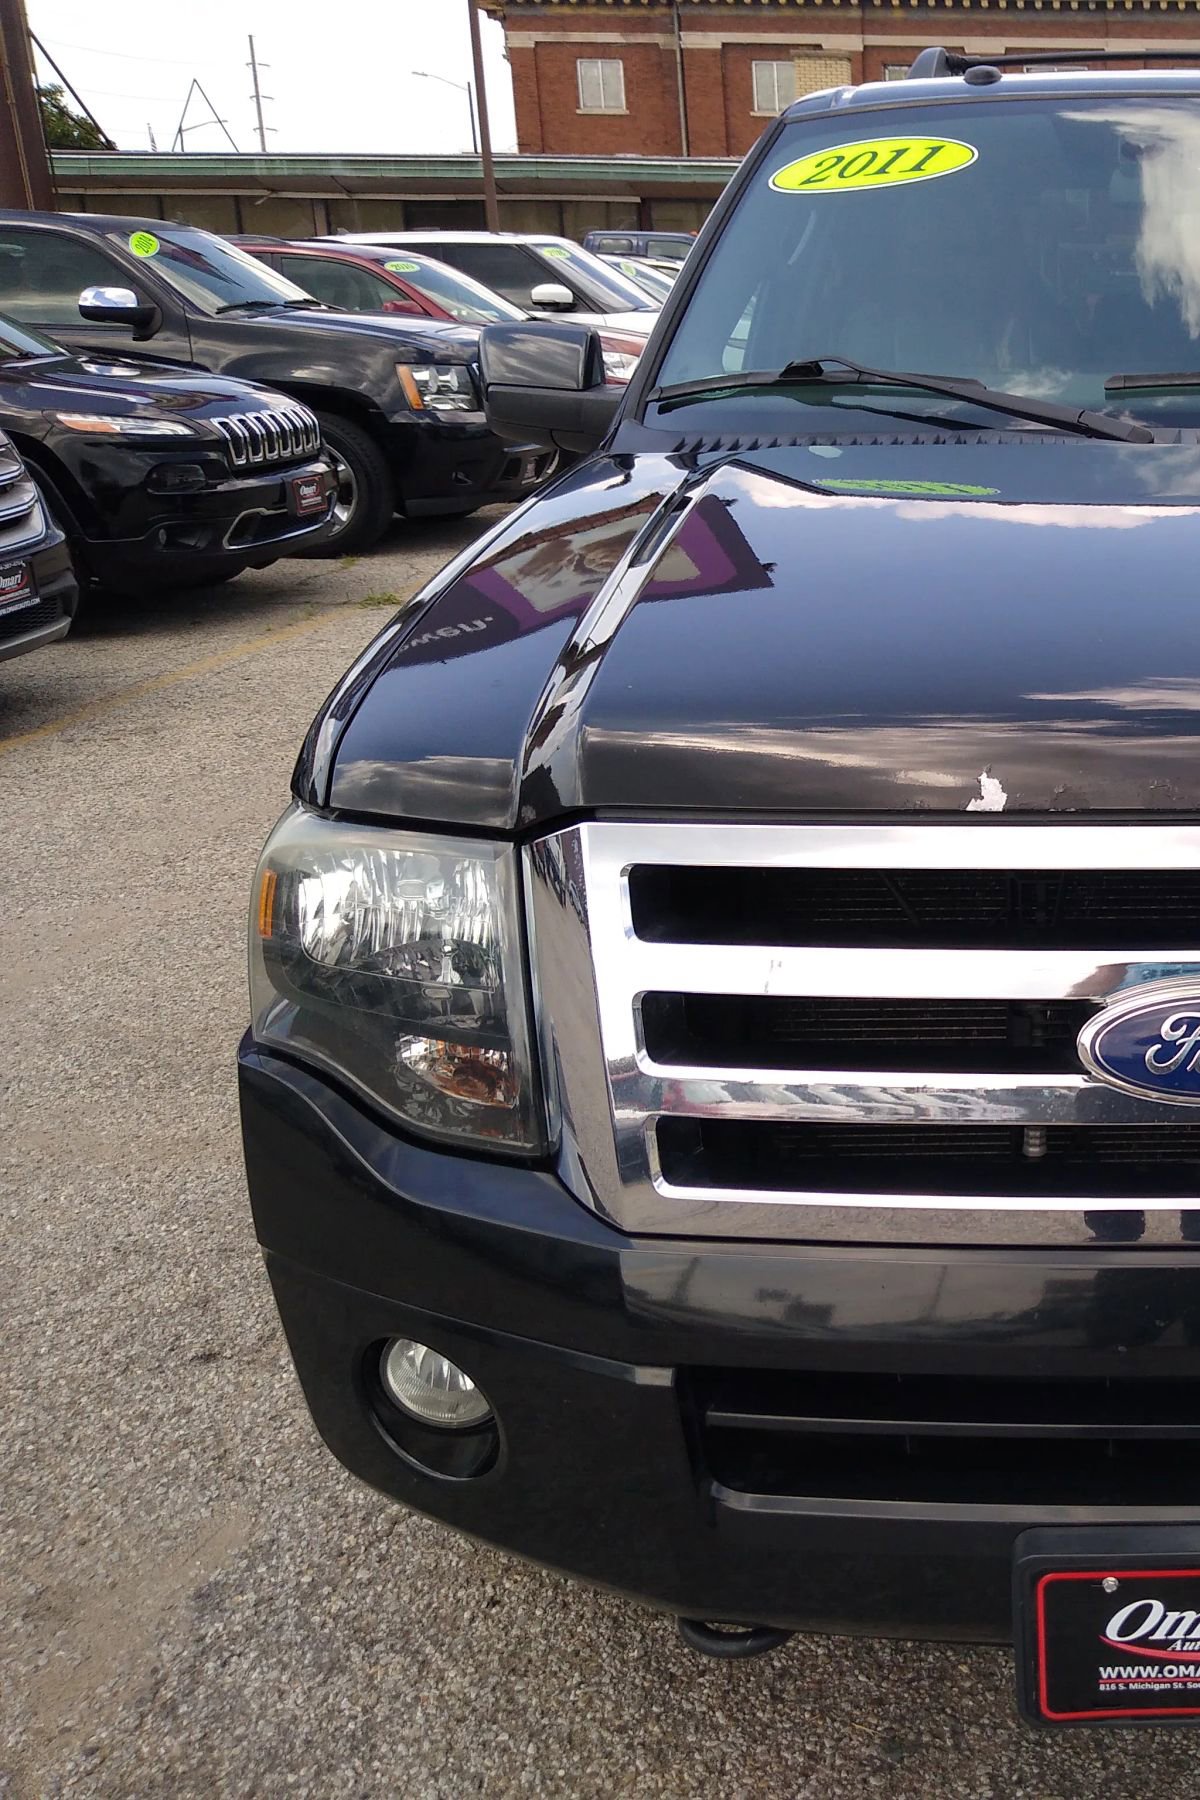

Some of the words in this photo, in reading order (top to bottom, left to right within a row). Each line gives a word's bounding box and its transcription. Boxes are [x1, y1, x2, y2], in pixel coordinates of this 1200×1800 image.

[798, 145, 946, 186] 2011
[135, 234, 155, 254] 2014
[1099, 1682, 1117, 1691] 816
[1118, 1682, 1127, 1691] S.
[1128, 1681, 1171, 1691] Michigan
[1172, 1681, 1186, 1690] St.
